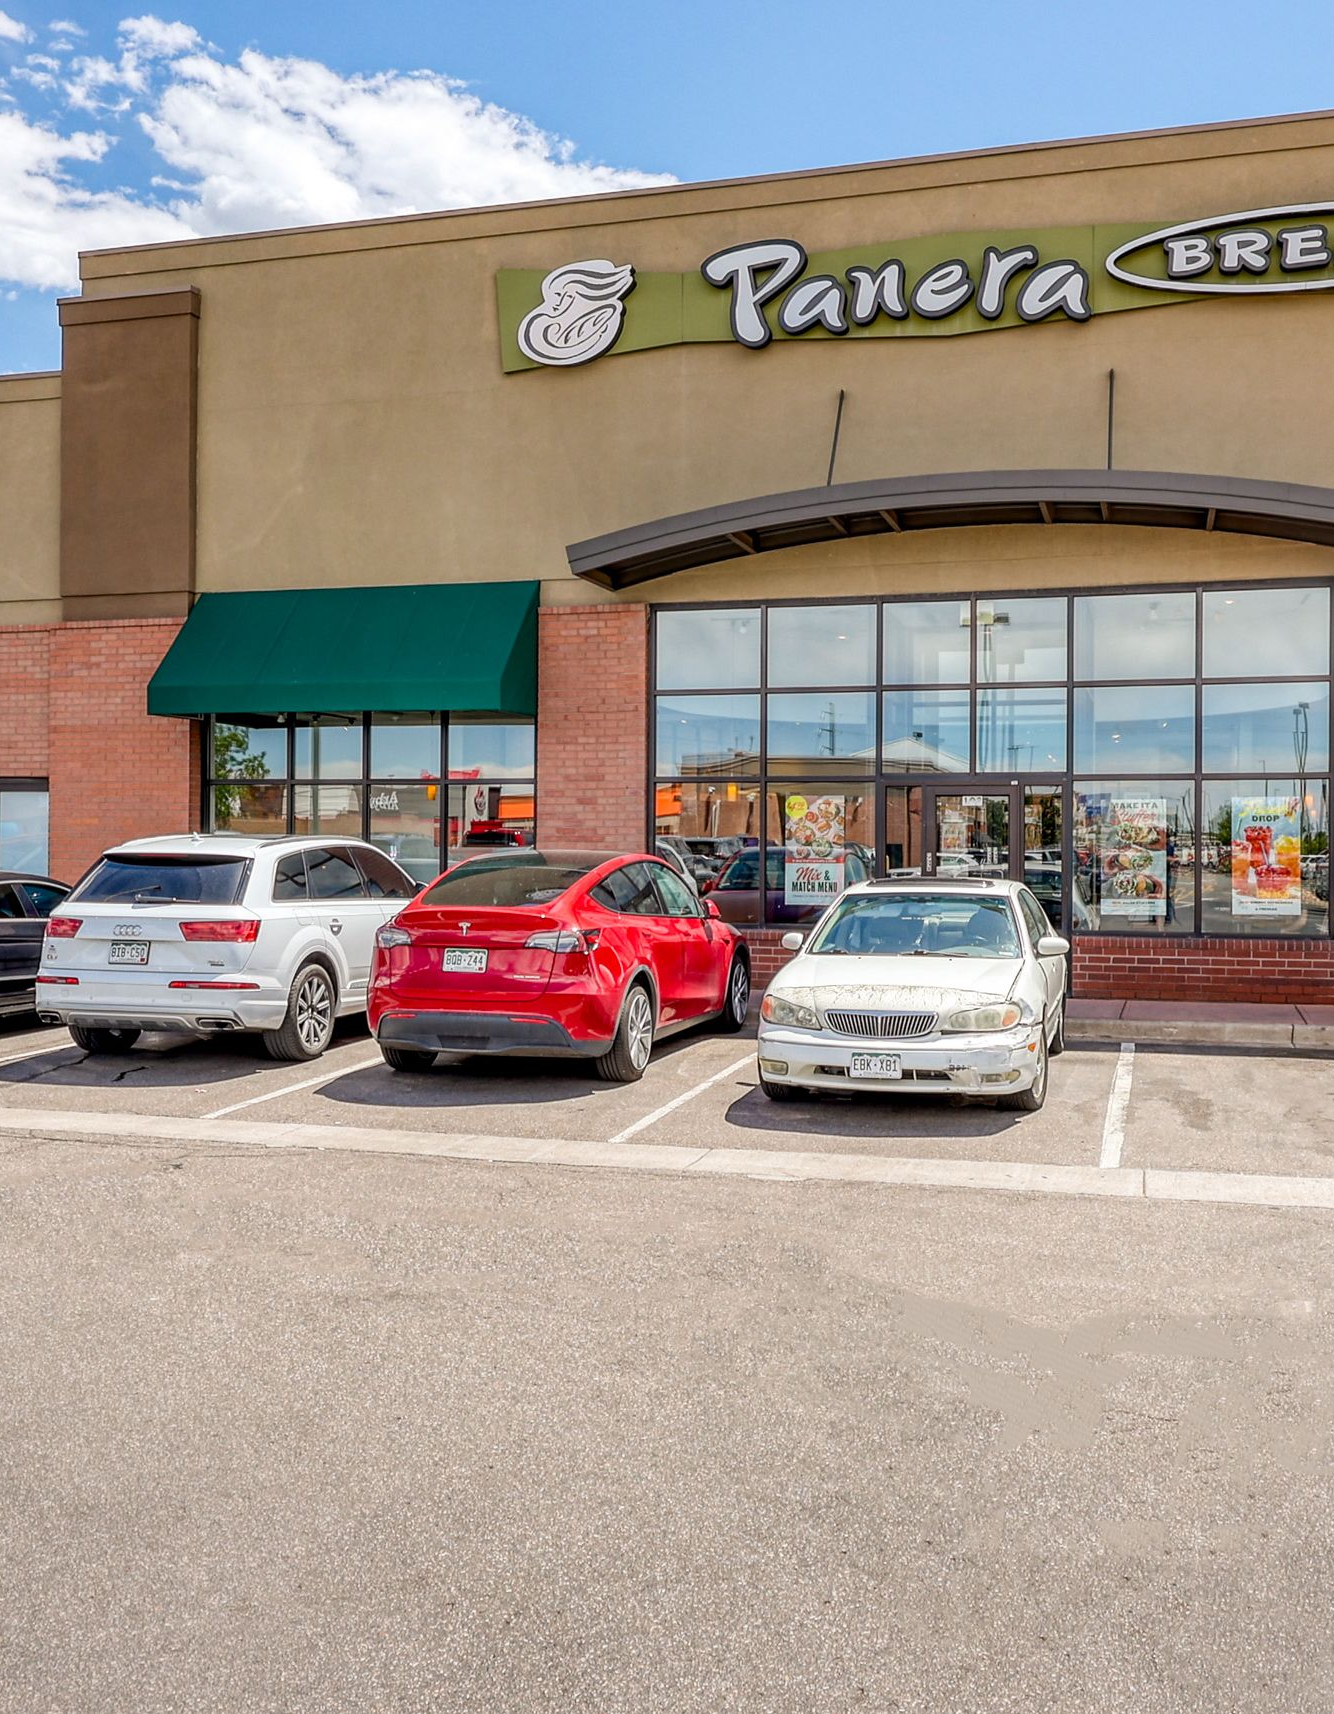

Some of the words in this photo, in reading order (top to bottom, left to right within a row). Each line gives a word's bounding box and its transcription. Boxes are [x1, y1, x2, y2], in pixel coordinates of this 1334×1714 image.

[703, 239, 1090, 347] Panera
[796, 867, 822, 881] Mix
[823, 870, 830, 881] &
[792, 881, 816, 892] MATCH
[818, 882, 838, 893] MENU
